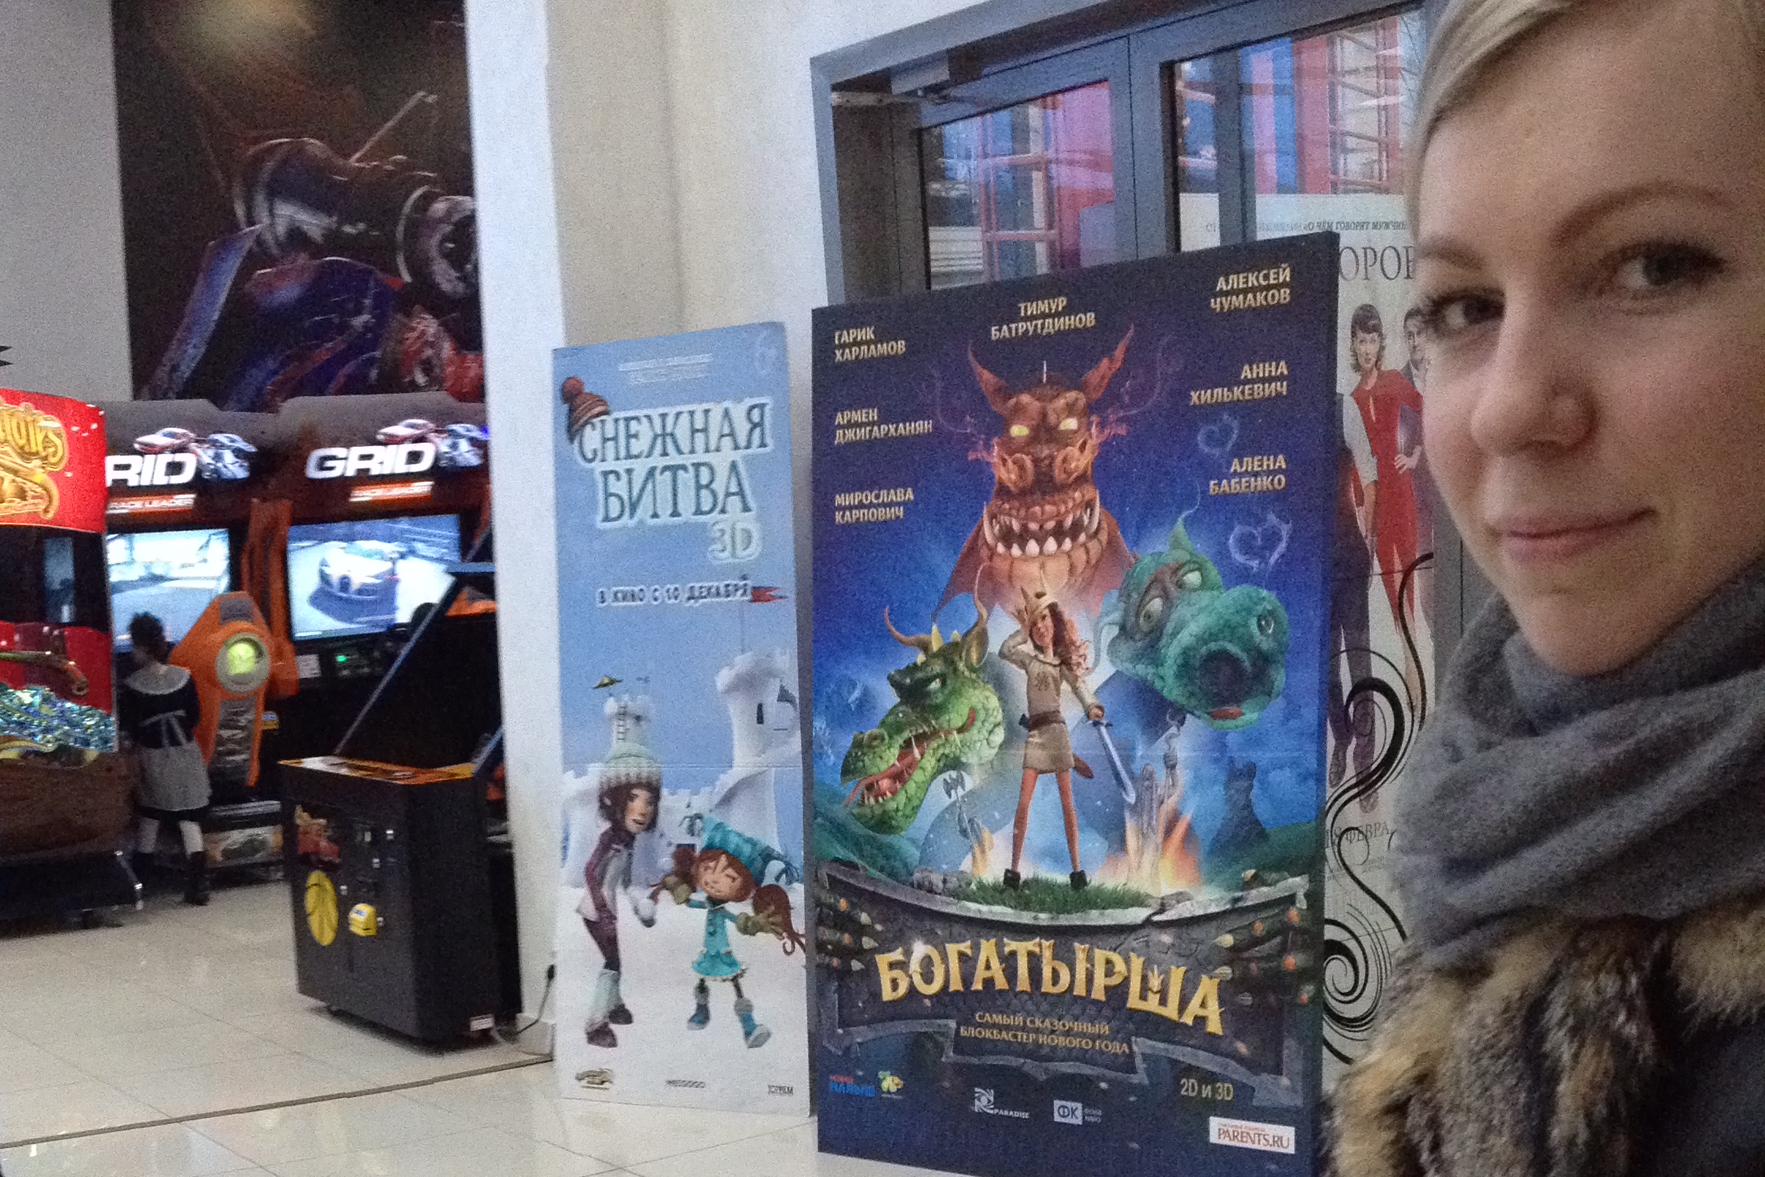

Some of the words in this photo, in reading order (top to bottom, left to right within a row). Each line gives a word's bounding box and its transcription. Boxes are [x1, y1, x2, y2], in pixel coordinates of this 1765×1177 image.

[1335, 220, 1370, 231] ГОВОРЯТ
[1371, 220, 1407, 231] МУЖЧИН
[1216, 263, 1291, 292] АЛЕКСЕЙ
[1018, 296, 1067, 317] ТИМУР
[1210, 288, 1291, 312] ЧУМАКОВ
[834, 326, 875, 345] ГАРИК
[990, 312, 1096, 341] БАТРУТДИНОВ
[834, 340, 906, 362] ХАРЛАМОВ
[1240, 360, 1288, 379] АННА
[1190, 381, 1288, 405] ХИЛЬКЕВИЧ
[835, 408, 878, 425] АРМЕН
[578, 402, 769, 464] СНЕЖНАЯ
[835, 420, 933, 445] ДЖИГАРХАНЯН
[106, 453, 197, 487] RID
[306, 442, 436, 480] GRID
[1231, 455, 1287, 472] АЛЕНА
[600, 460, 753, 523] БИТВА
[1209, 474, 1286, 495] БАБЕНКО
[835, 487, 914, 507] МИРОСЛАВА
[835, 506, 904, 525] КАРПОВИЧ
[710, 522, 760, 561] 3D
[612, 587, 645, 603] КИНО
[685, 580, 749, 602] ДЕКАБРЯ
[1345, 821, 1391, 844] ФЕВРА
[875, 938, 1224, 1035] БОГАТЫРША
[975, 1011, 1023, 1026] САМЫЙ
[1026, 1016, 1111, 1035] СКАЗОЧНЫЙ
[960, 1026, 1036, 1044] БЛОКБАСТЕР
[1038, 1034, 1093, 1050] НОВОГО
[1095, 1040, 1130, 1055] ГОДА
[1180, 1078, 1199, 1097] 2D
[1201, 1083, 1212, 1098] и
[1215, 1082, 1234, 1101] 3D
[993, 1109, 1029, 1119] PARADISE
[1057, 1105, 1079, 1120] ФК
[1218, 1127, 1290, 1149] PARENTS.RU
